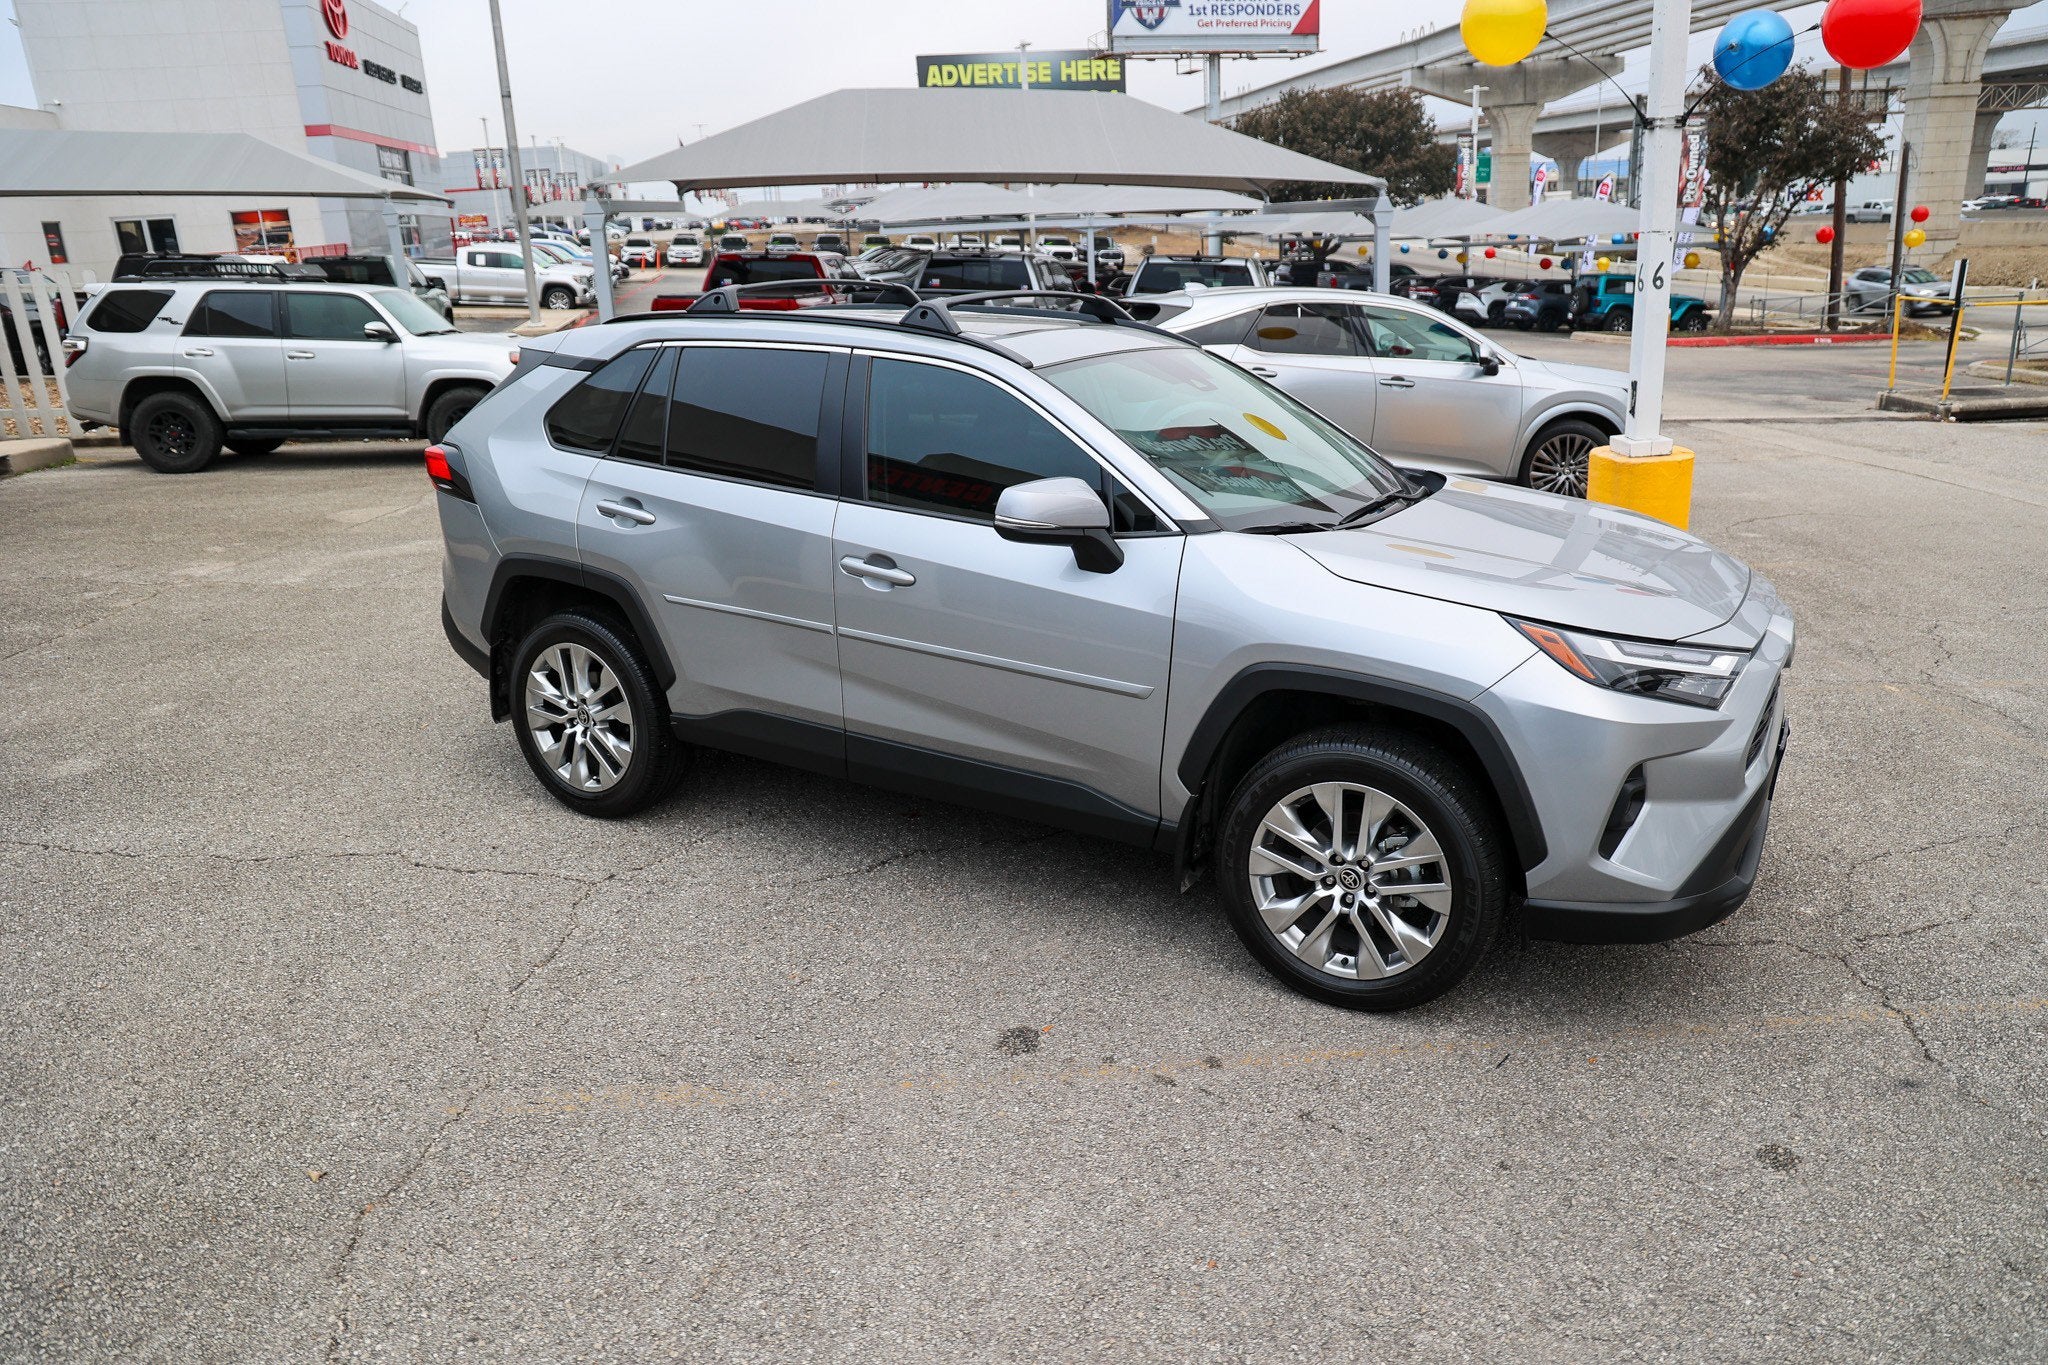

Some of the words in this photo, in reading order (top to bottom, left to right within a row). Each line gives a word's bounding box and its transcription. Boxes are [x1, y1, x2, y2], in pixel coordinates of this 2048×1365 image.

[1189, 5, 1207, 15] 1st
[1211, 4, 1300, 15] RESPONDERS
[1197, 19, 1213, 28] Get
[1216, 18, 1258, 28] Preferred
[1260, 18, 1292, 29] Pricing
[926, 61, 1052, 88] ADVERTISE
[1060, 59, 1121, 83] HERE
[1787, 182, 1824, 201] FEx
[1652, 261, 1665, 290] 6
